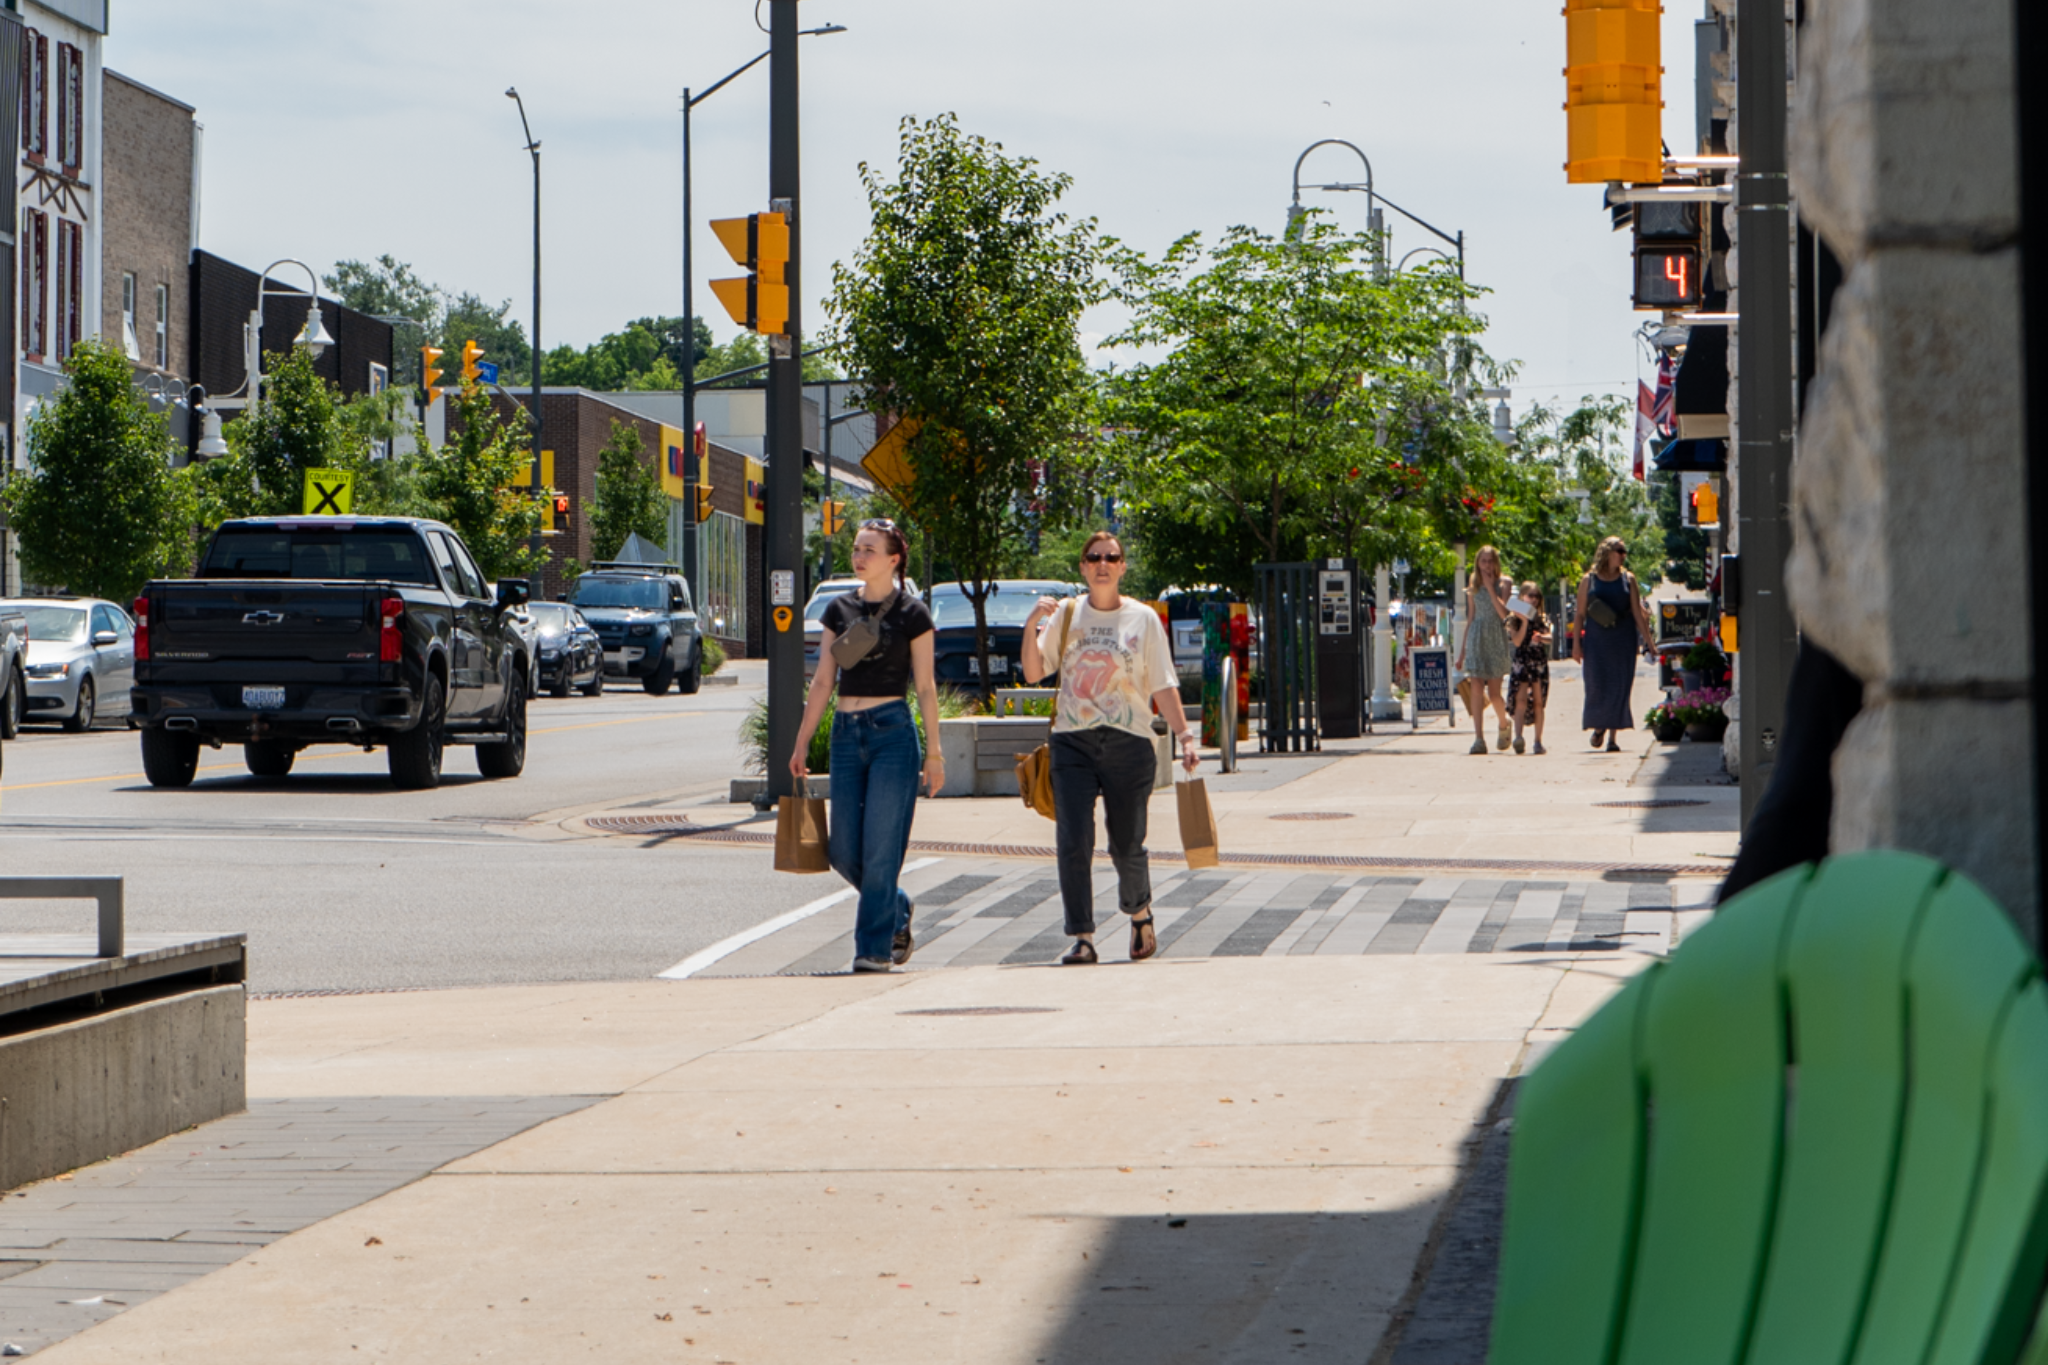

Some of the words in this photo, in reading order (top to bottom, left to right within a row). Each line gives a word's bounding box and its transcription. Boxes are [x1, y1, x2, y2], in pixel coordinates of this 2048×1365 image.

[1665, 255, 1687, 298] 4
[309, 472, 350, 482] COURTESY
[1090, 627, 1113, 636] THE
[1102, 638, 1133, 674] STONES
[1418, 668, 1444, 679] FRESH
[1416, 678, 1447, 690] SCONES
[1417, 689, 1448, 699] AVAILABLE
[1419, 699, 1446, 710] TODAY
